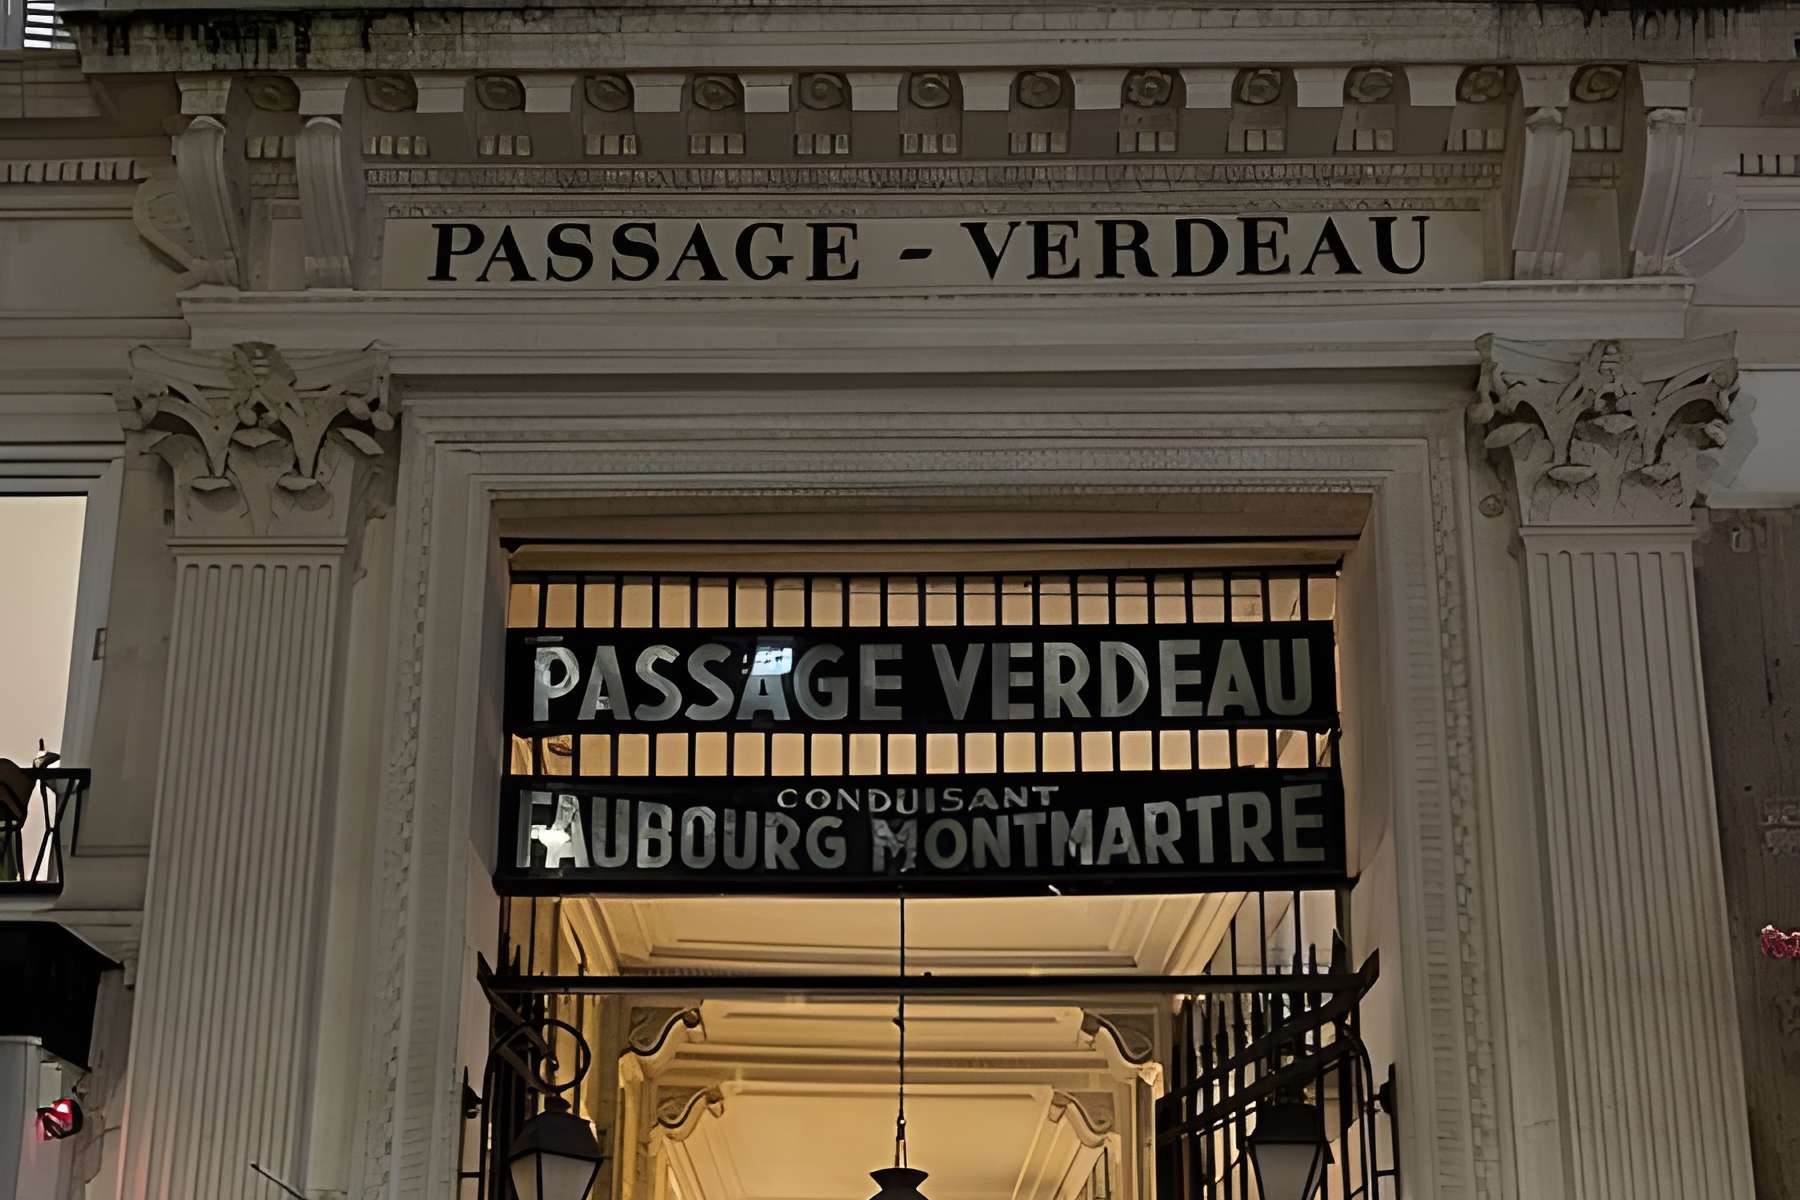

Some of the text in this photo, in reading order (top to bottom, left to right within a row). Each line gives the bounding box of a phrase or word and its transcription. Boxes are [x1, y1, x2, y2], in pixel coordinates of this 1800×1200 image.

[427, 221, 860, 282] PASSAGE
[959, 215, 1430, 281] VERDEAU
[533, 637, 1313, 722] PASSAGE VERDEAU
[515, 783, 1327, 873] FAUBOURG MONTMARTRE
[776, 785, 1060, 815] CONDUISANT
